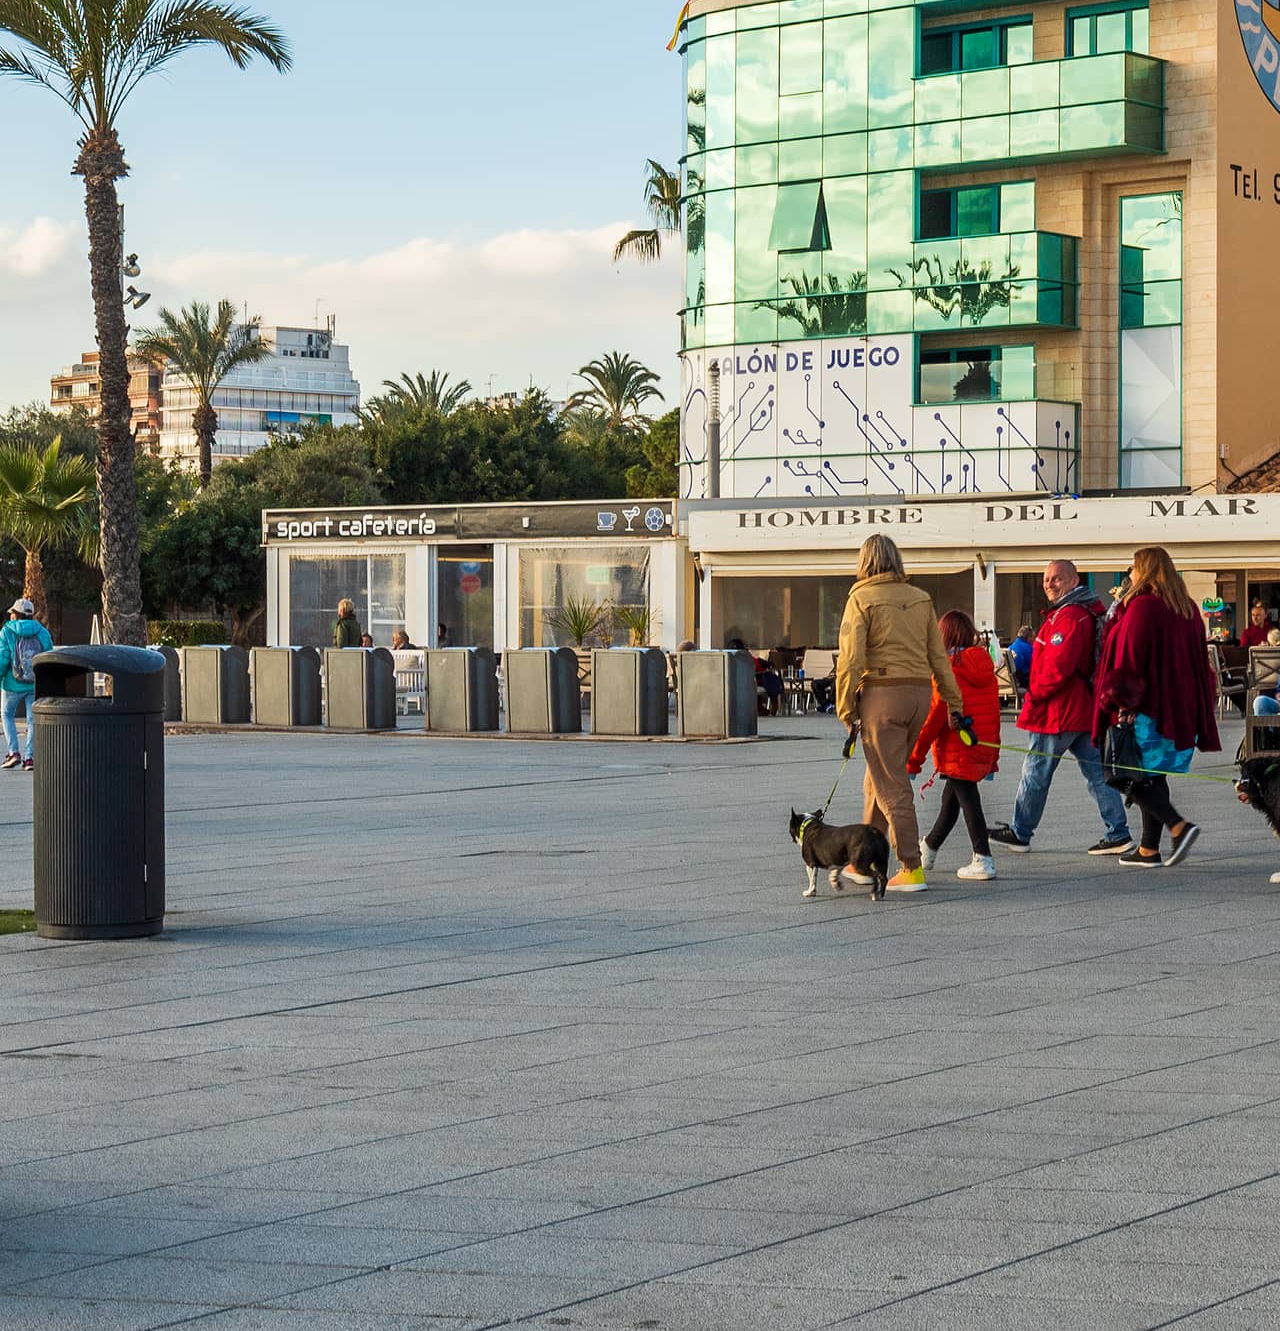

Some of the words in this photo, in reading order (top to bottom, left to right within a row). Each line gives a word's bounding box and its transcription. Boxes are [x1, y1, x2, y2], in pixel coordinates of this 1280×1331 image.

[786, 351, 814, 372] DE
[826, 346, 901, 370] JUEGO
[276, 516, 334, 541] sport
[338, 512, 437, 537] cafetería
[736, 506, 924, 529] HOMBRE
[984, 504, 1080, 524] DEL
[1145, 498, 1260, 519] MAR
